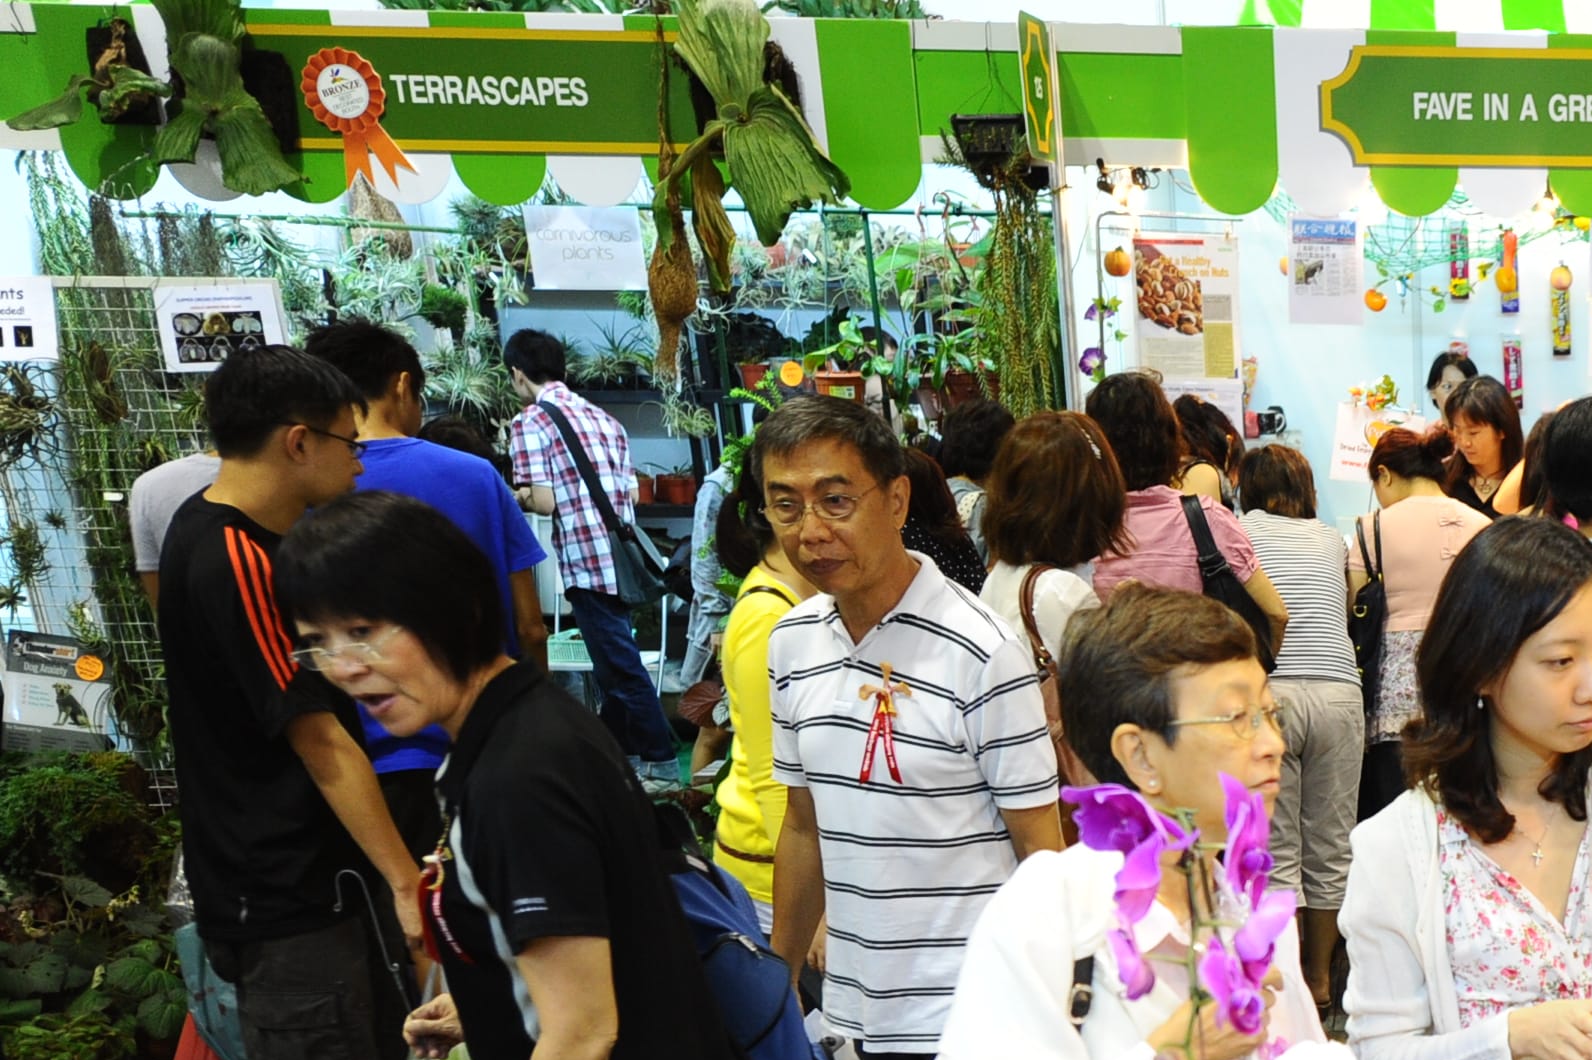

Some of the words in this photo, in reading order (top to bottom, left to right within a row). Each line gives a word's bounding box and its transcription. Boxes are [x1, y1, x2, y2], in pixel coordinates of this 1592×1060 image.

[321, 79, 361, 98] BRONZE
[389, 73, 589, 108] TERRASCAPES
[1413, 92, 1473, 121] FAVE
[1483, 93, 1508, 122] IN
[1519, 93, 1538, 122] A
[536, 227, 632, 243] carnivorous
[561, 245, 615, 262] plants
[23, 661, 39, 674] Dog
